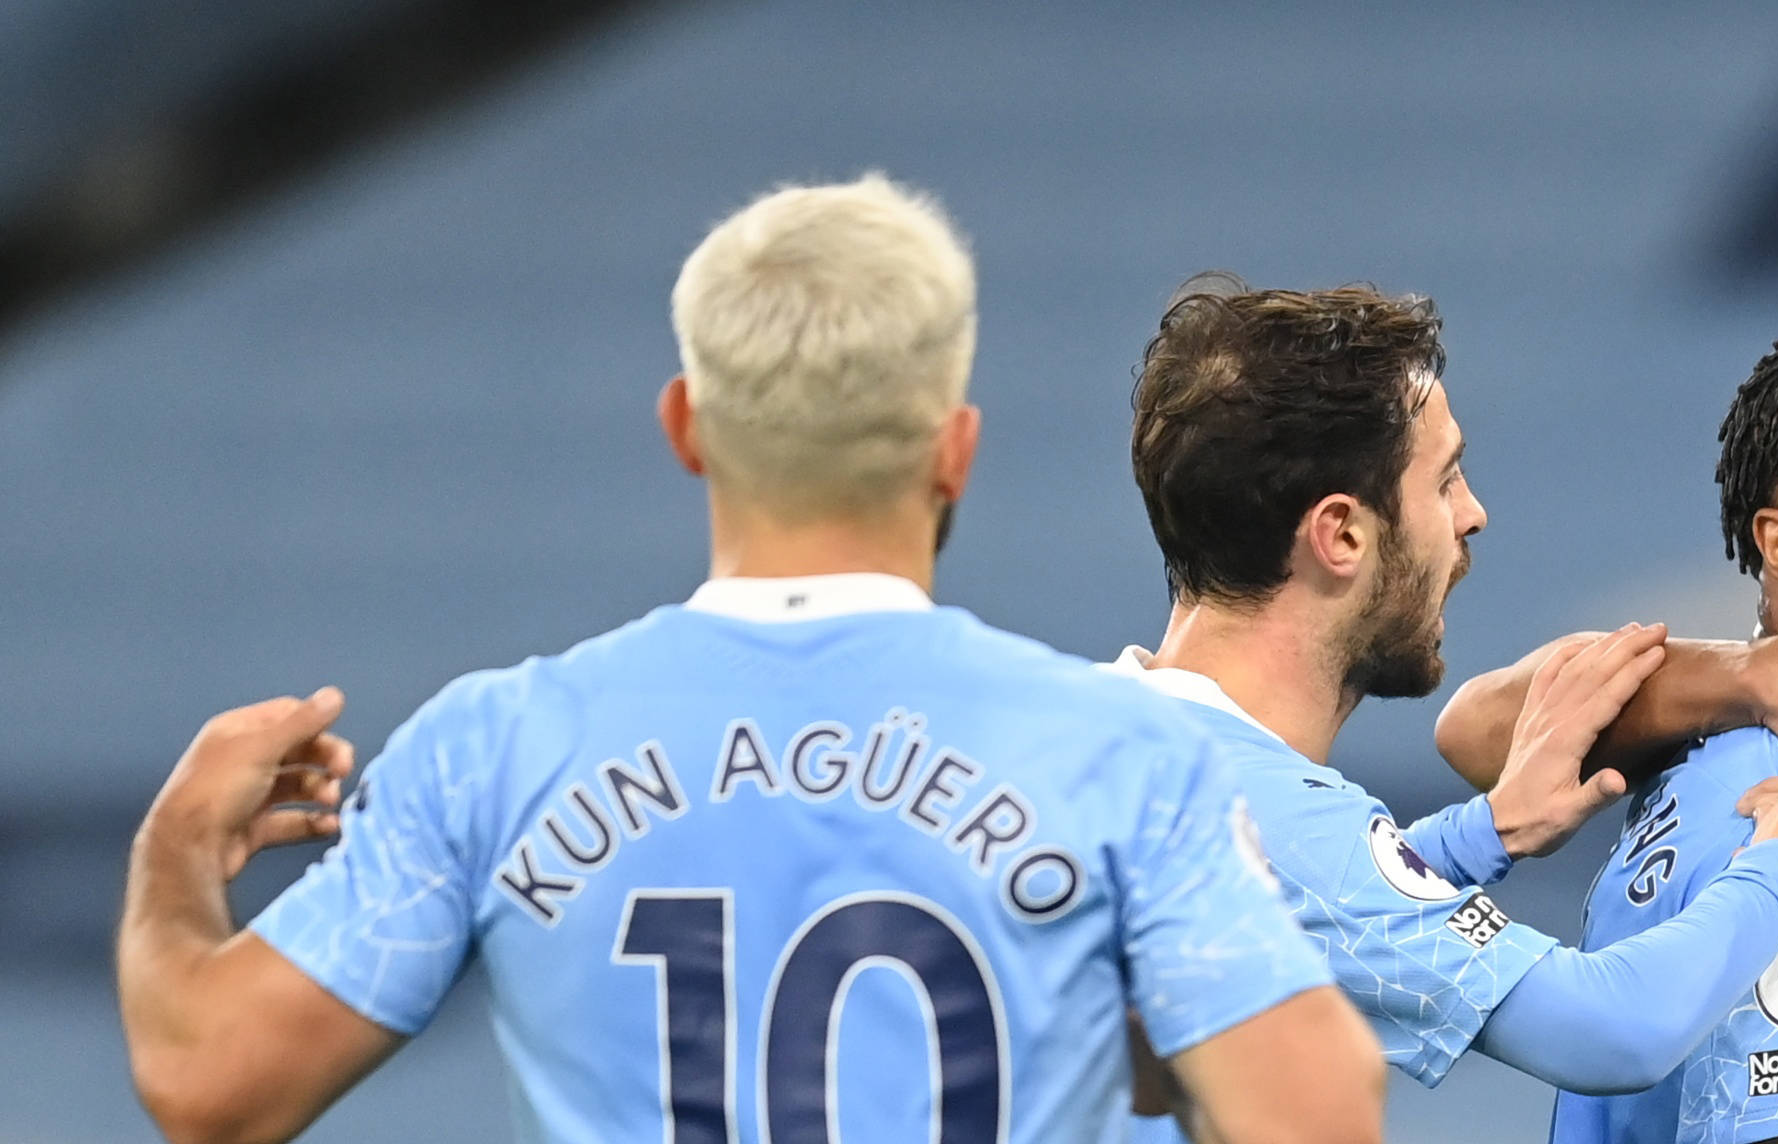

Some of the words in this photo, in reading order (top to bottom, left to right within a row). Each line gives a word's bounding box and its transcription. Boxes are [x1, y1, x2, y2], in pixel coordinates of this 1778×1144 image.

[495, 740, 689, 927] KUN
[711, 705, 1087, 923] AGÜERO
[1622, 783, 1680, 908] NG
